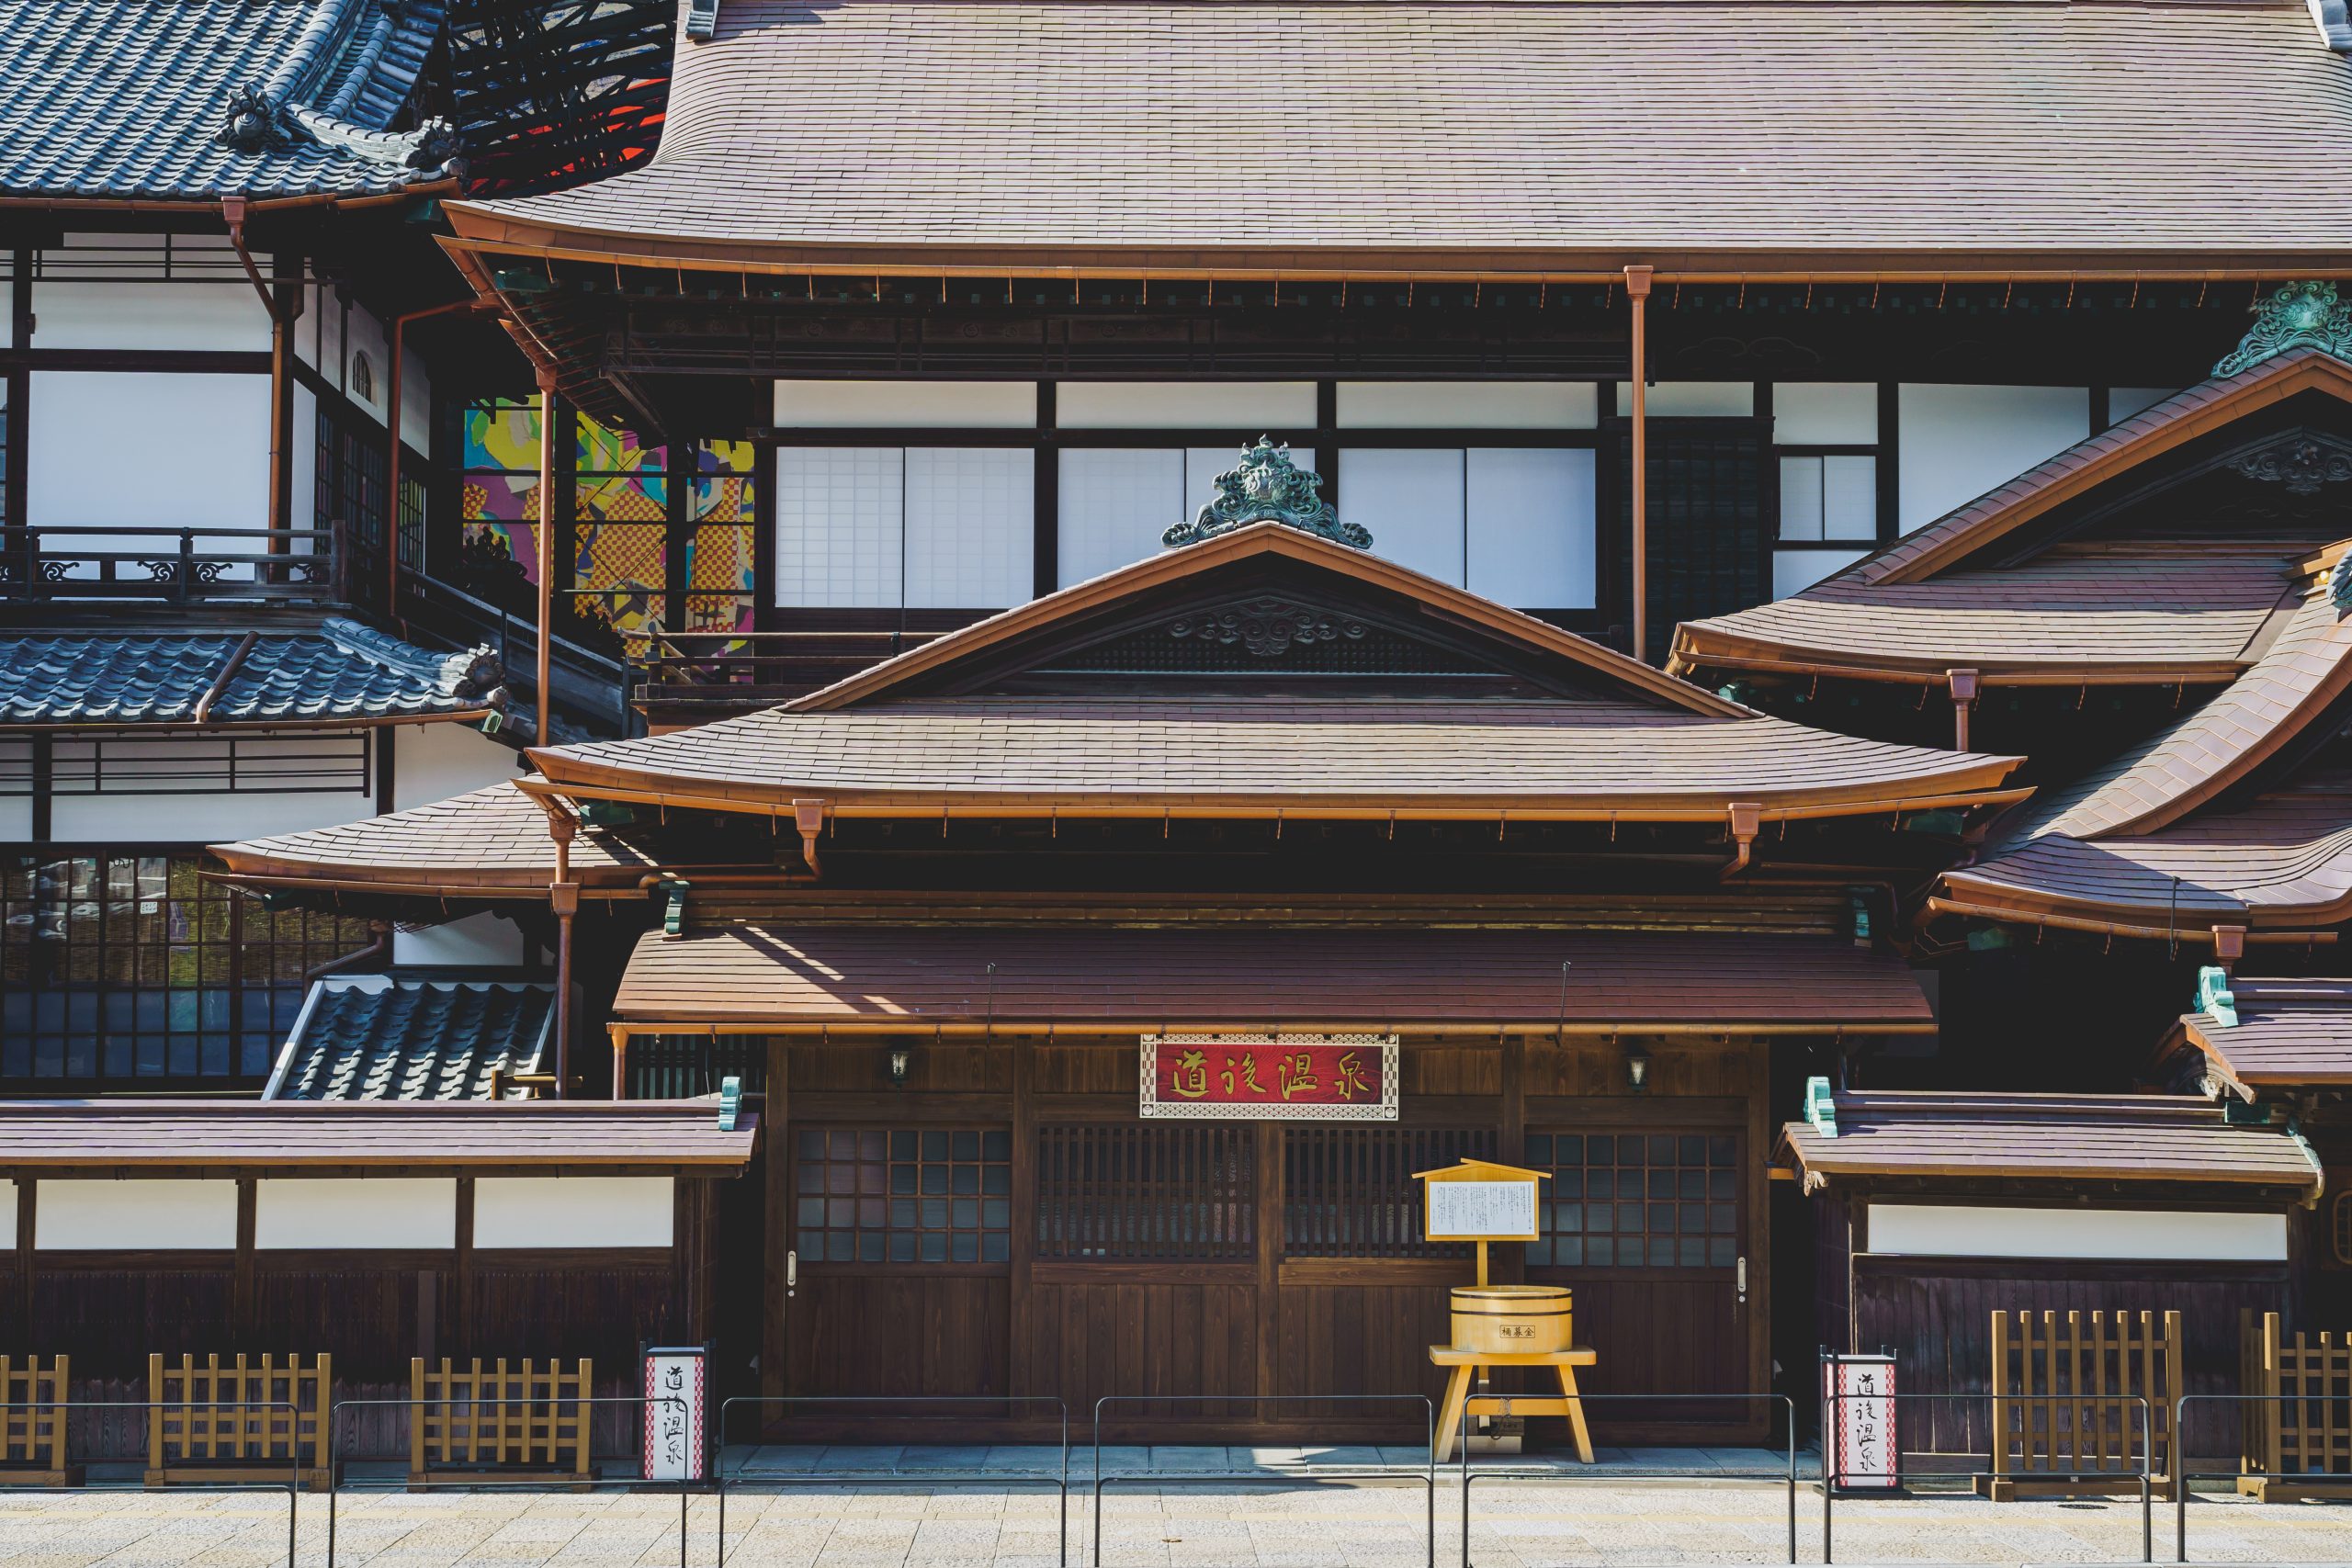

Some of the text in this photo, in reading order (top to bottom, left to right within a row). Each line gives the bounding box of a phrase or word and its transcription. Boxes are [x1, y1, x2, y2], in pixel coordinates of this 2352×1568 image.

[1170, 1049, 1370, 1100] 道後温泉
[1501, 1325, 1534, 1337] 桶募金
[662, 1366, 686, 1466] 道後温泉
[1855, 1373, 1878, 1472] 道後温泉
